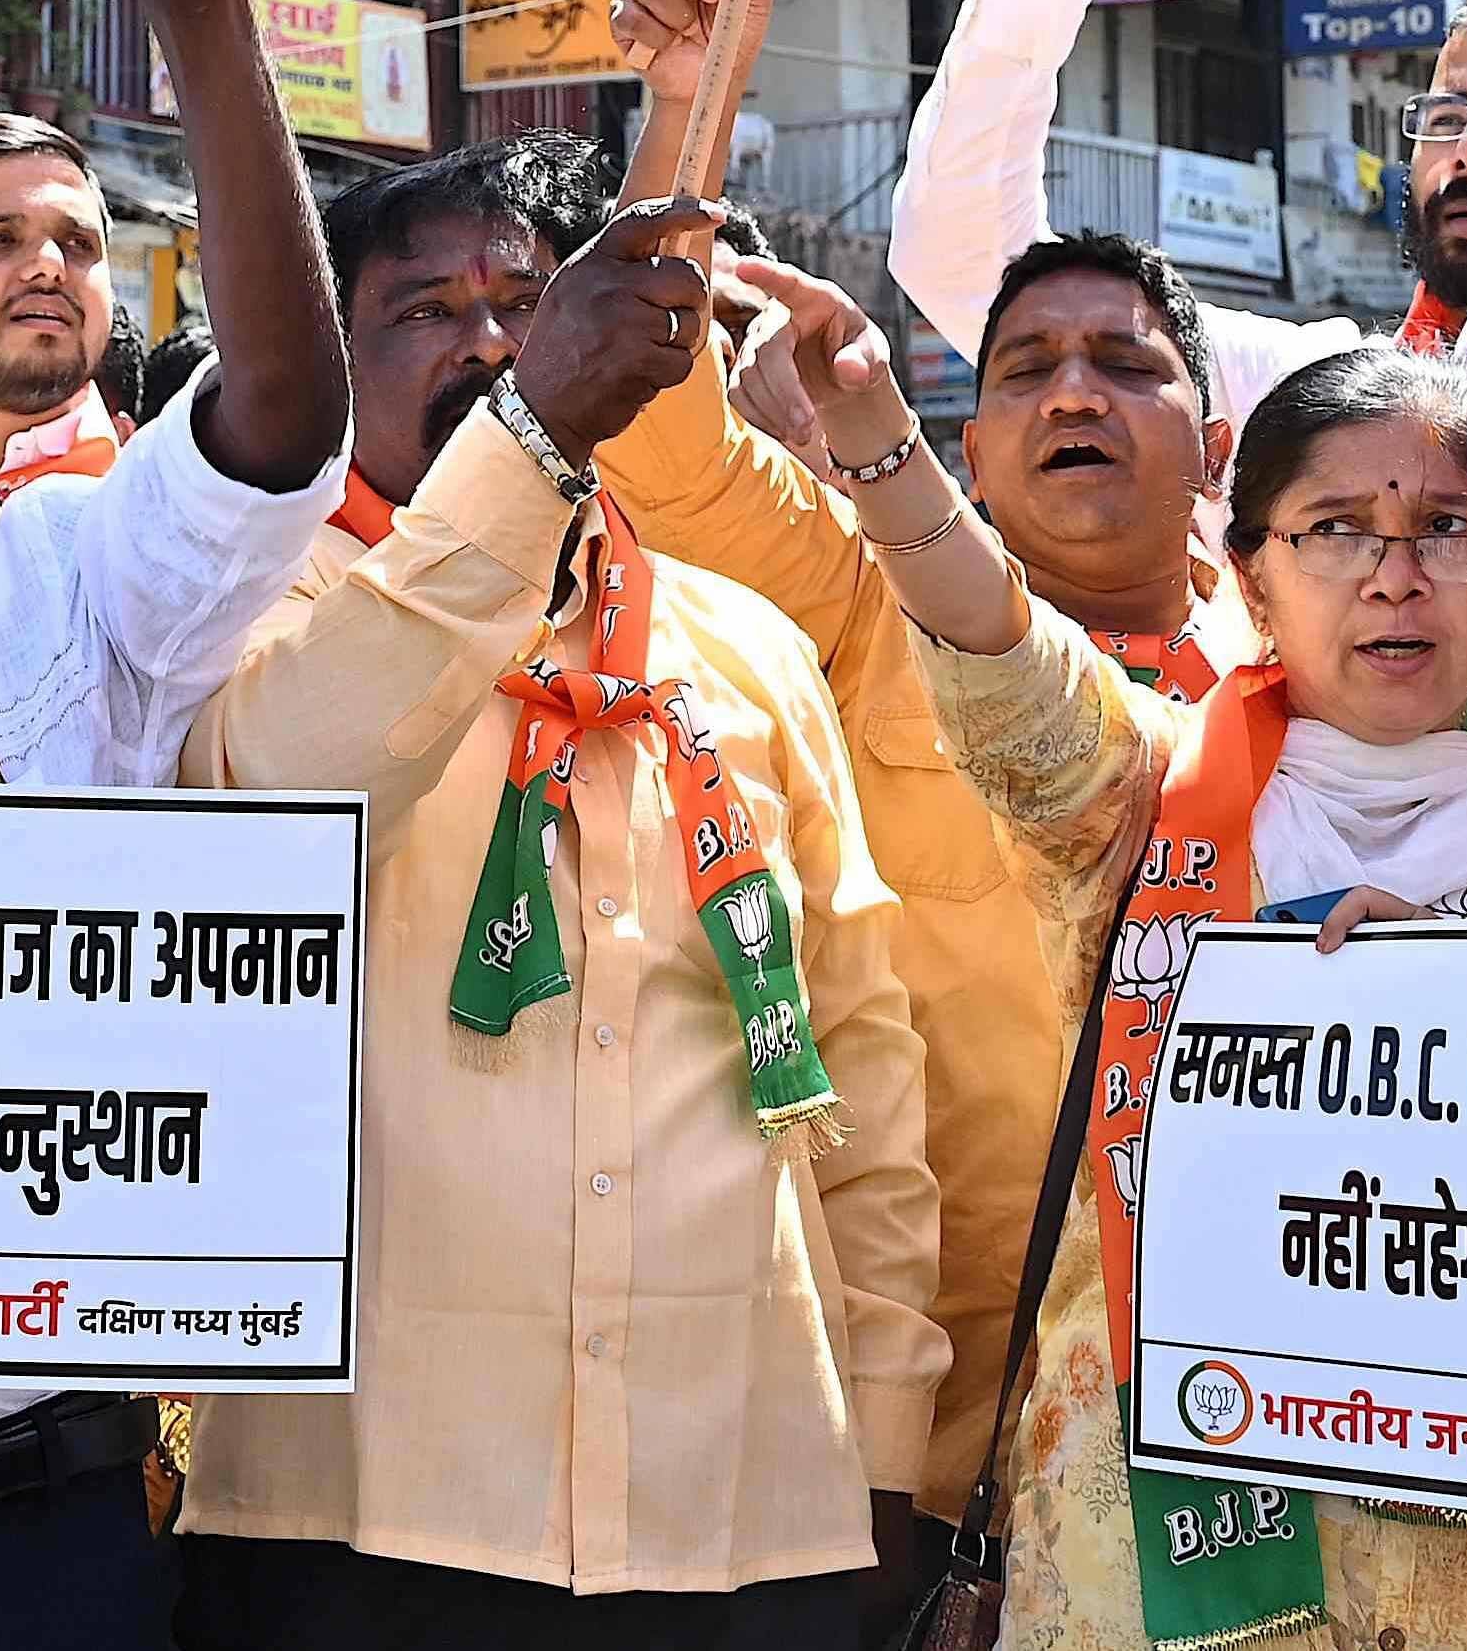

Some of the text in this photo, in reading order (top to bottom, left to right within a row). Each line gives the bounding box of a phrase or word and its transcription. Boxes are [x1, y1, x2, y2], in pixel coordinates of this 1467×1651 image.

[1301, 3, 1435, 46] Top-10
[64, 908, 137, 1005] का
[149, 909, 346, 1008] अपमान
[1169, 1021, 1318, 1115] समस्त
[1317, 1021, 1461, 1128] O.B.C.
[1278, 1169, 1383, 1290] नहीं
[75, 1298, 164, 1339] दक्षिण
[167, 1306, 232, 1341] मध्य
[236, 1298, 302, 1348] मुंबई
[1259, 1387, 1410, 1453] भारतीय
[1164, 1483, 1296, 1569] B.J.P.
